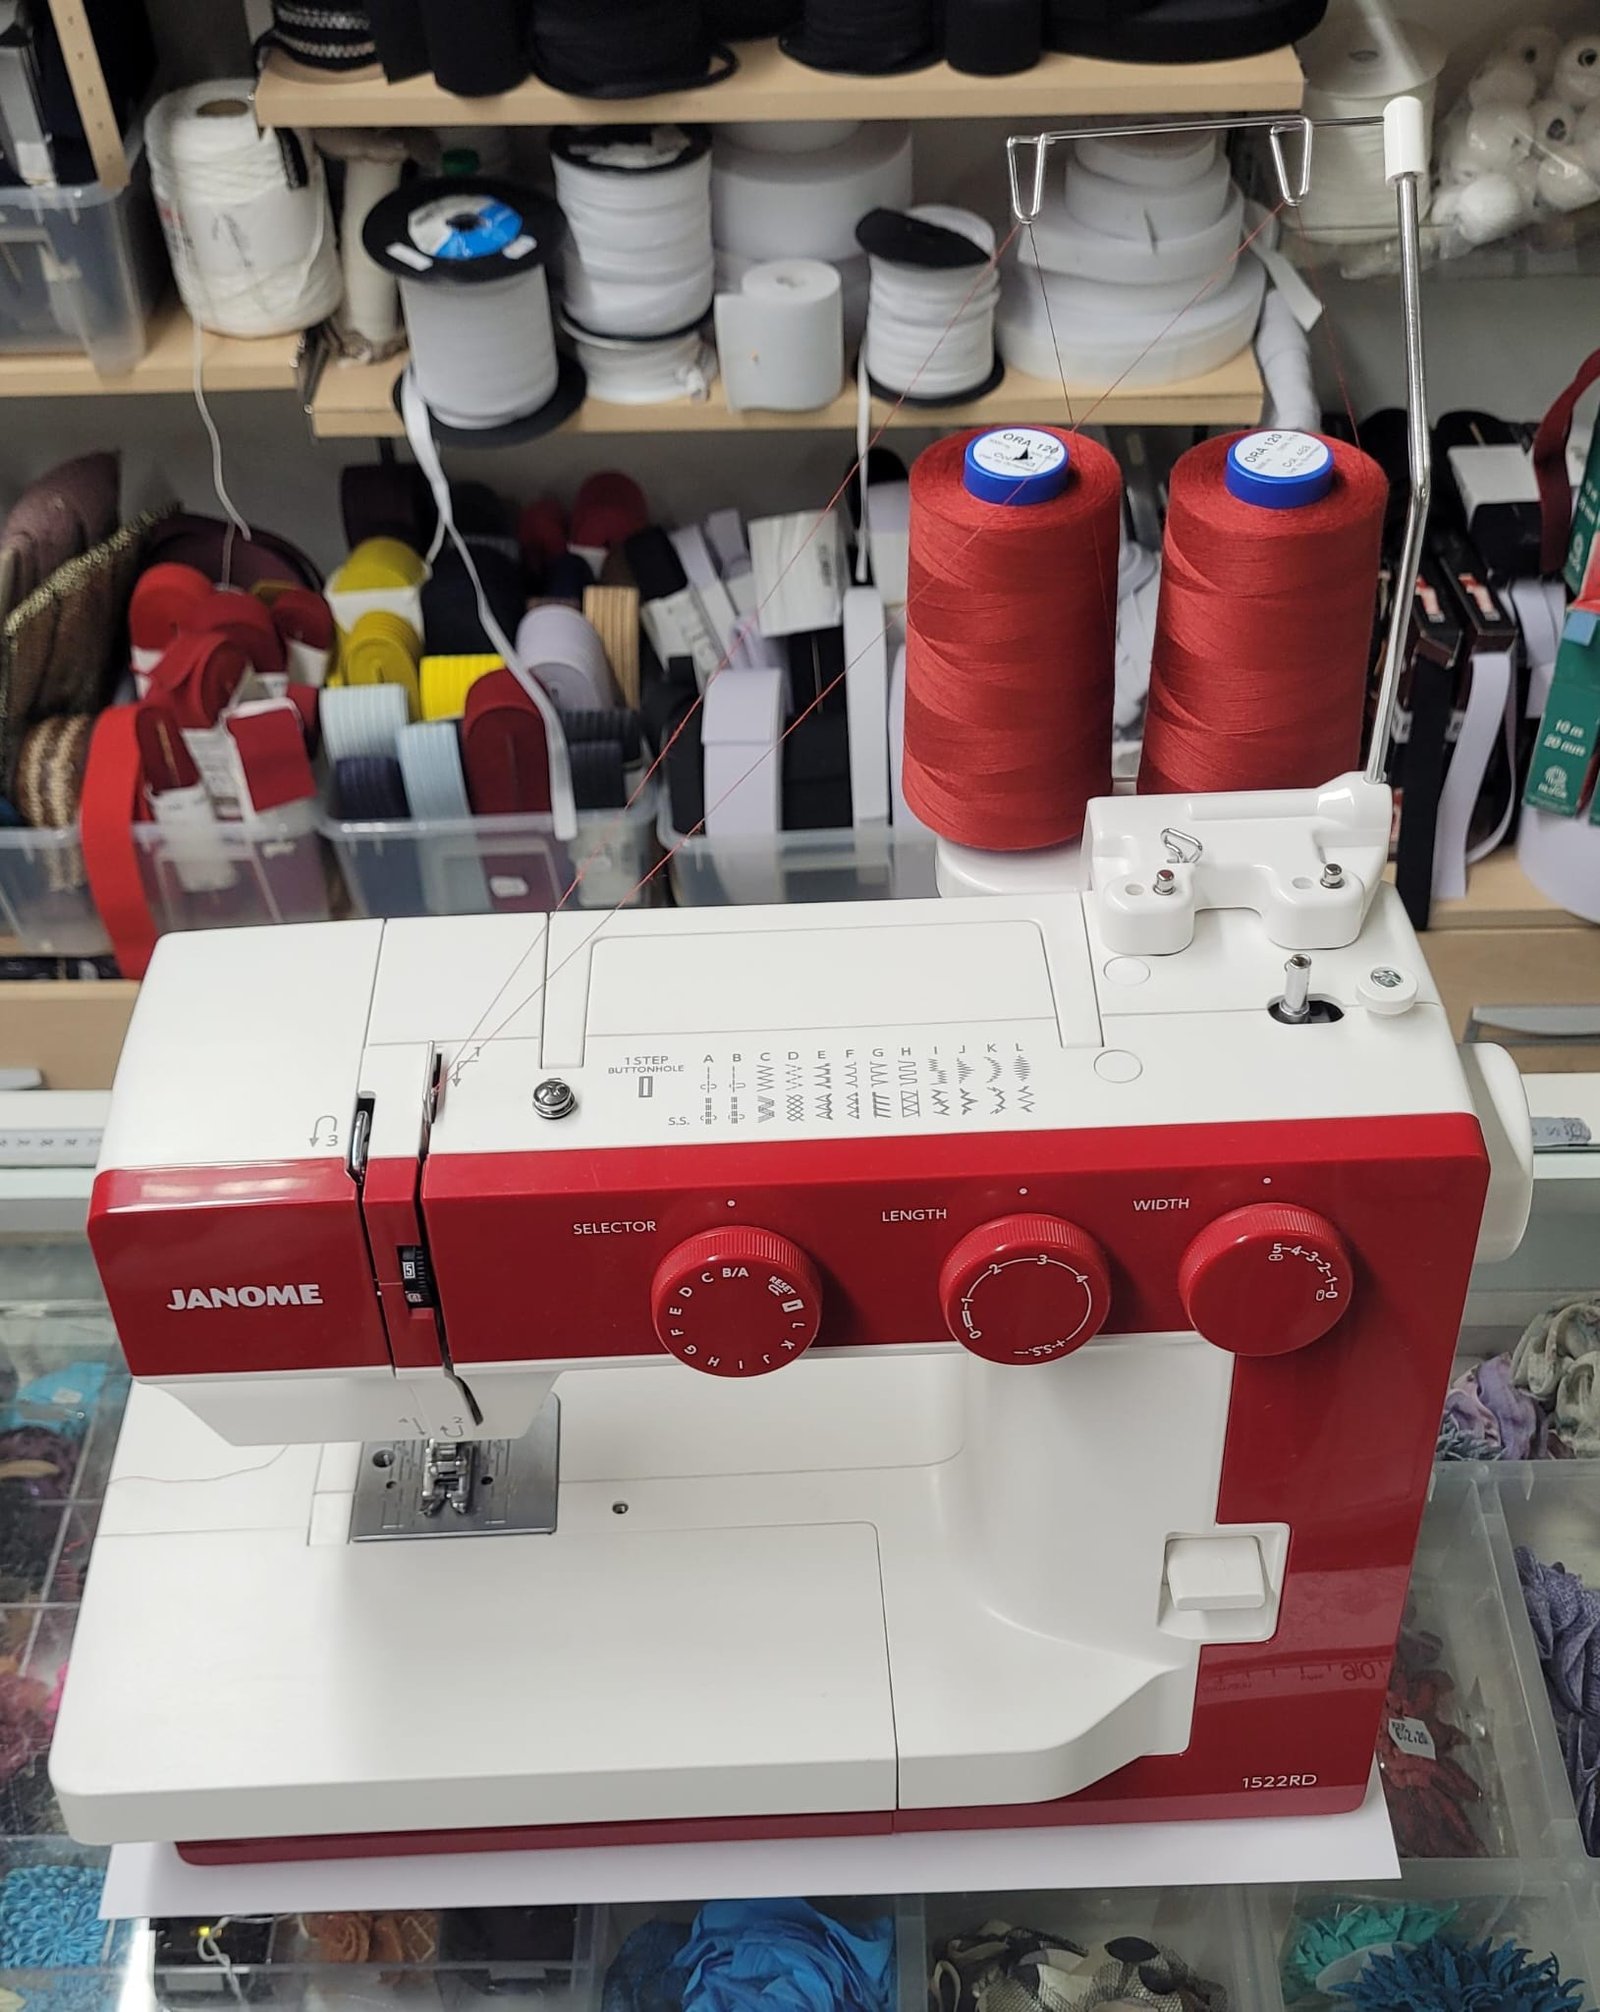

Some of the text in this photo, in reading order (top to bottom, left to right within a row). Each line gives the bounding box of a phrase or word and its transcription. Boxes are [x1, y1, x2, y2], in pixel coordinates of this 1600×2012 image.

[1003, 433, 1031, 446] ORA
[1037, 444, 1060, 454] 120
[1244, 447, 1268, 463] ORA
[1264, 433, 1282, 446] 120
[703, 1043, 1024, 1063] A B C D E F G H I J K L
[634, 1055, 669, 1066] STEP
[608, 1064, 684, 1074] BUTTONHOLE
[325, 1134, 338, 1147] 3
[1133, 1198, 1190, 1211] WIDTH
[882, 1208, 947, 1222] LENGTH
[573, 1220, 657, 1235] SELECTOR
[701, 1272, 714, 1283] C
[722, 1267, 749, 1279] B/A
[768, 1275, 796, 1296] RESET
[166, 1284, 323, 1310] JANOME
[679, 1286, 693, 1298] D
[669, 1307, 682, 1316] E
[670, 1328, 684, 1336] F
[684, 1344, 697, 1355] G
[781, 1339, 796, 1350] K
[707, 1356, 720, 1367] H
[762, 1354, 771, 1364] J
[1242, 1774, 1317, 1790] 1522RD
